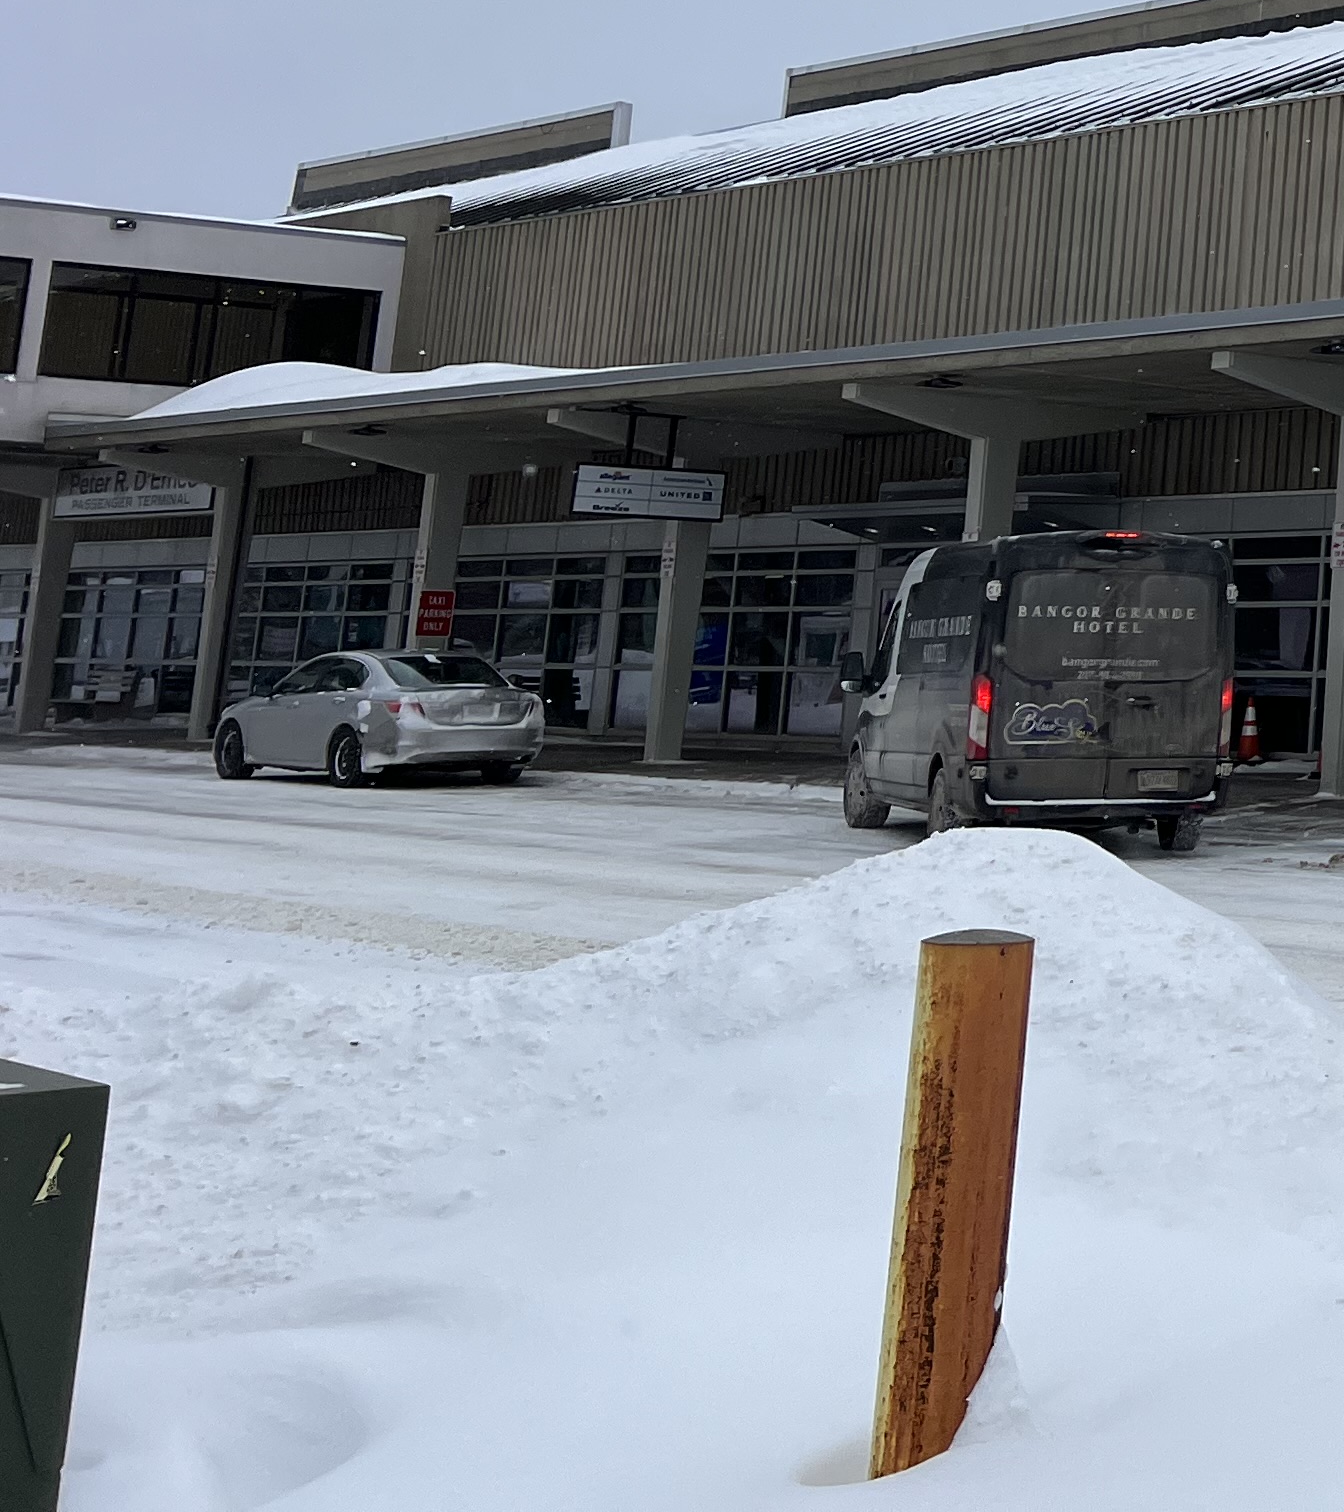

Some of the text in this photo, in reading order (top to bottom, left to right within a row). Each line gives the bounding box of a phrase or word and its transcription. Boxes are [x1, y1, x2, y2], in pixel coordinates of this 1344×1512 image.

[70, 473, 111, 495] Peter
[604, 487, 633, 495] DELTA
[659, 490, 700, 500] UNITED
[71, 493, 190, 510] PASSENGER TERMINAL
[428, 595, 446, 605] TAXI
[419, 609, 452, 618] PARKING
[1017, 605, 1197, 620] BANGOR GRANDE
[423, 622, 443, 631] ONLY
[1073, 621, 1144, 634] HOTEL
